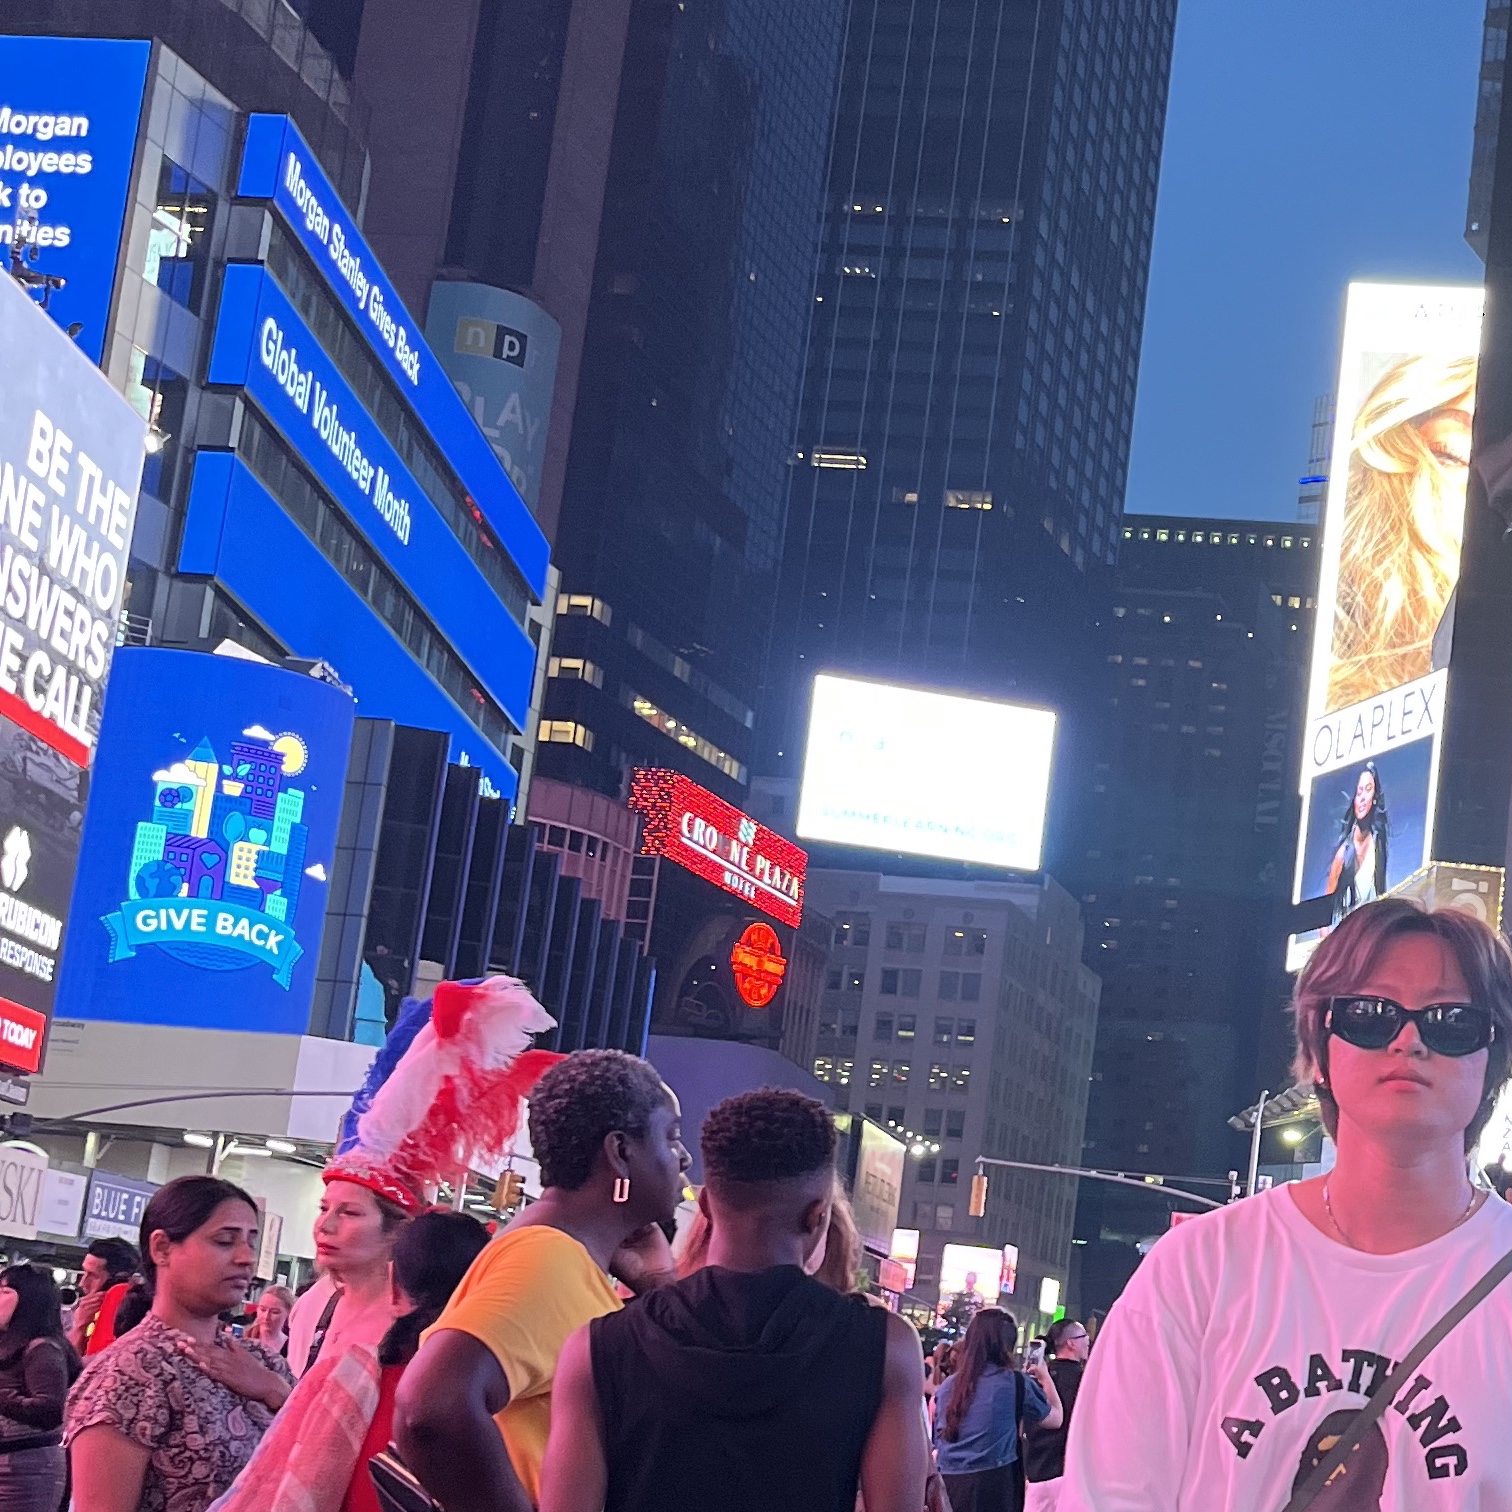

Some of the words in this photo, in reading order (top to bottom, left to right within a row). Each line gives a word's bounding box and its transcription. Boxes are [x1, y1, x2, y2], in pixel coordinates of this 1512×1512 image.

[18, 182, 48, 209] to
[284, 152, 330, 246] Morgan
[329, 224, 371, 310] Stanley
[368, 286, 396, 349] Gives
[394, 326, 421, 386] Back
[260, 317, 313, 415] Global
[312, 381, 375, 495] Volunteer
[373, 466, 411, 546] Month
[26, 409, 73, 497] BE
[76, 451, 131, 550] THE
[48, 505, 119, 611] WHO
[25, 649, 94, 748] CALL
[1314, 684, 1436, 767] OLAPLEX
[755, 854, 799, 900] PLAZA
[0, 892, 62, 950] RUBICON
[135, 908, 209, 932] GIVE
[215, 912, 285, 955] BACK
[0, 937, 56, 981] RESPONSE
[2, 1019, 37, 1050] TODAY
[92, 1187, 129, 1221] BLUE
[1220, 1416, 1265, 1460] A
[1253, 1348, 1468, 1480] BATHING
